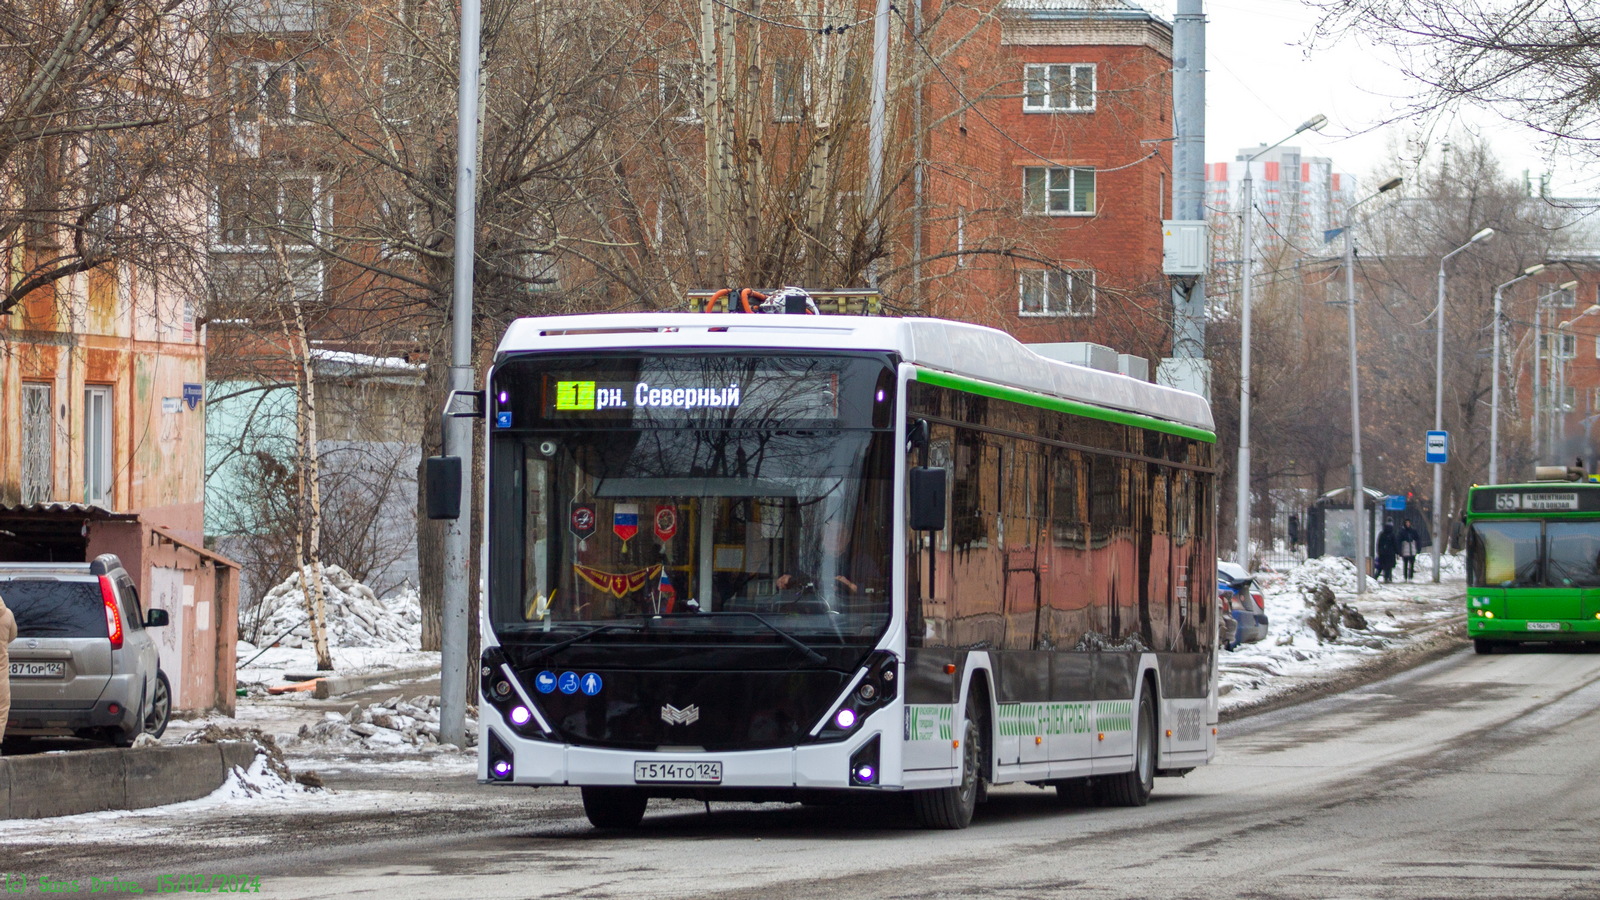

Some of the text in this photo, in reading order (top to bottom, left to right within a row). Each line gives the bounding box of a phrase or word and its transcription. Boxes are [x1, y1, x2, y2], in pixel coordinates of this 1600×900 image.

[571, 383, 740, 410] 1 рн. Северный
[1497, 494, 1515, 510] 55
[46, 663, 61, 672] 124
[1037, 703, 1091, 735] Я-ЭЛЕКТРОБУС
[640, 764, 718, 779] Т514ТО 124
